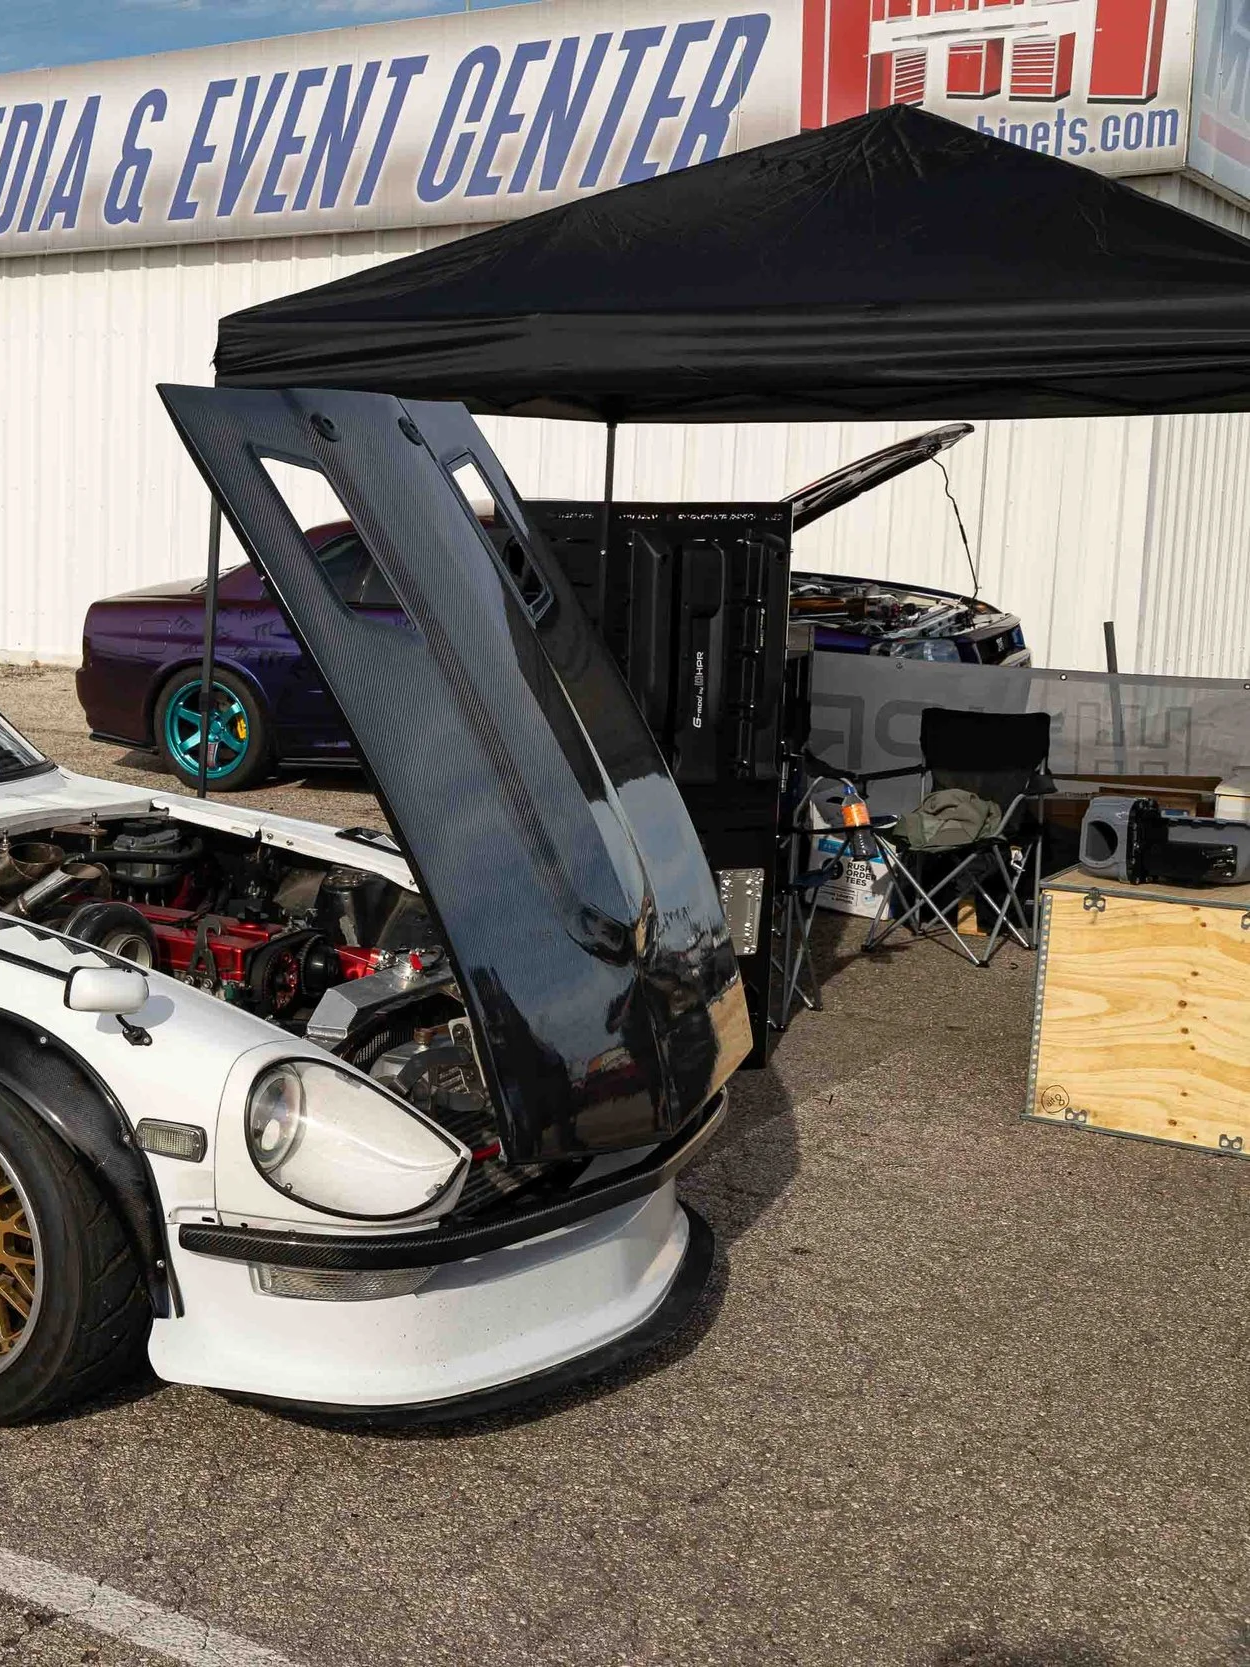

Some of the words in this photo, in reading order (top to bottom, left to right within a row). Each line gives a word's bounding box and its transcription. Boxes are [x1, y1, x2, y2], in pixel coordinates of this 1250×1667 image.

[103, 90, 168, 225] &
[168, 56, 430, 221] EVENT
[416, 13, 771, 203] CENTER
[847, 862, 872, 873] RUSH
[845, 869, 877, 881] ORDER
[845, 877, 867, 887] TEES
